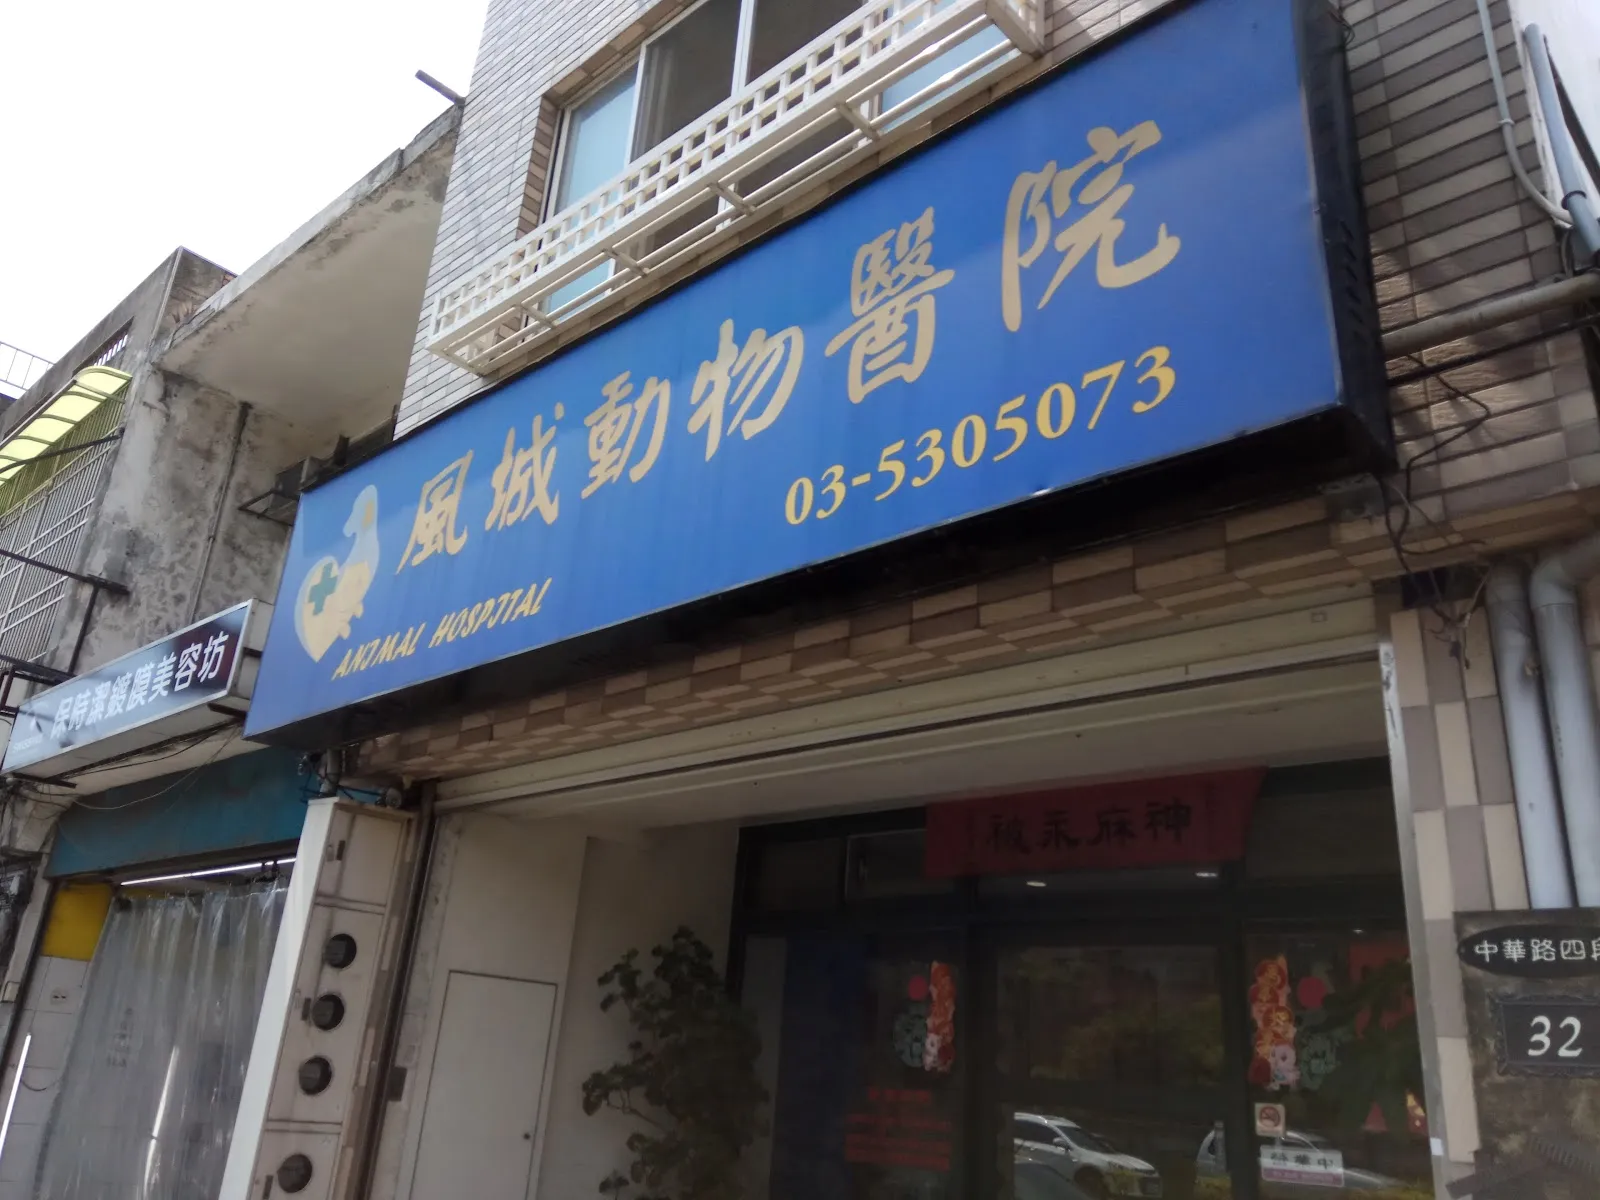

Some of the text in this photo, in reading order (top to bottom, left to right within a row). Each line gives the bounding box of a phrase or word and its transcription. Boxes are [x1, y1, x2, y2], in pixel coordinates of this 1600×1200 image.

[397, 119, 1181, 575] 風城動物醫院
[786, 345, 1177, 526] 03-5305073
[331, 577, 552, 680] ANIMAL HOSPITAL
[1527, 1014, 1583, 1058] 32
